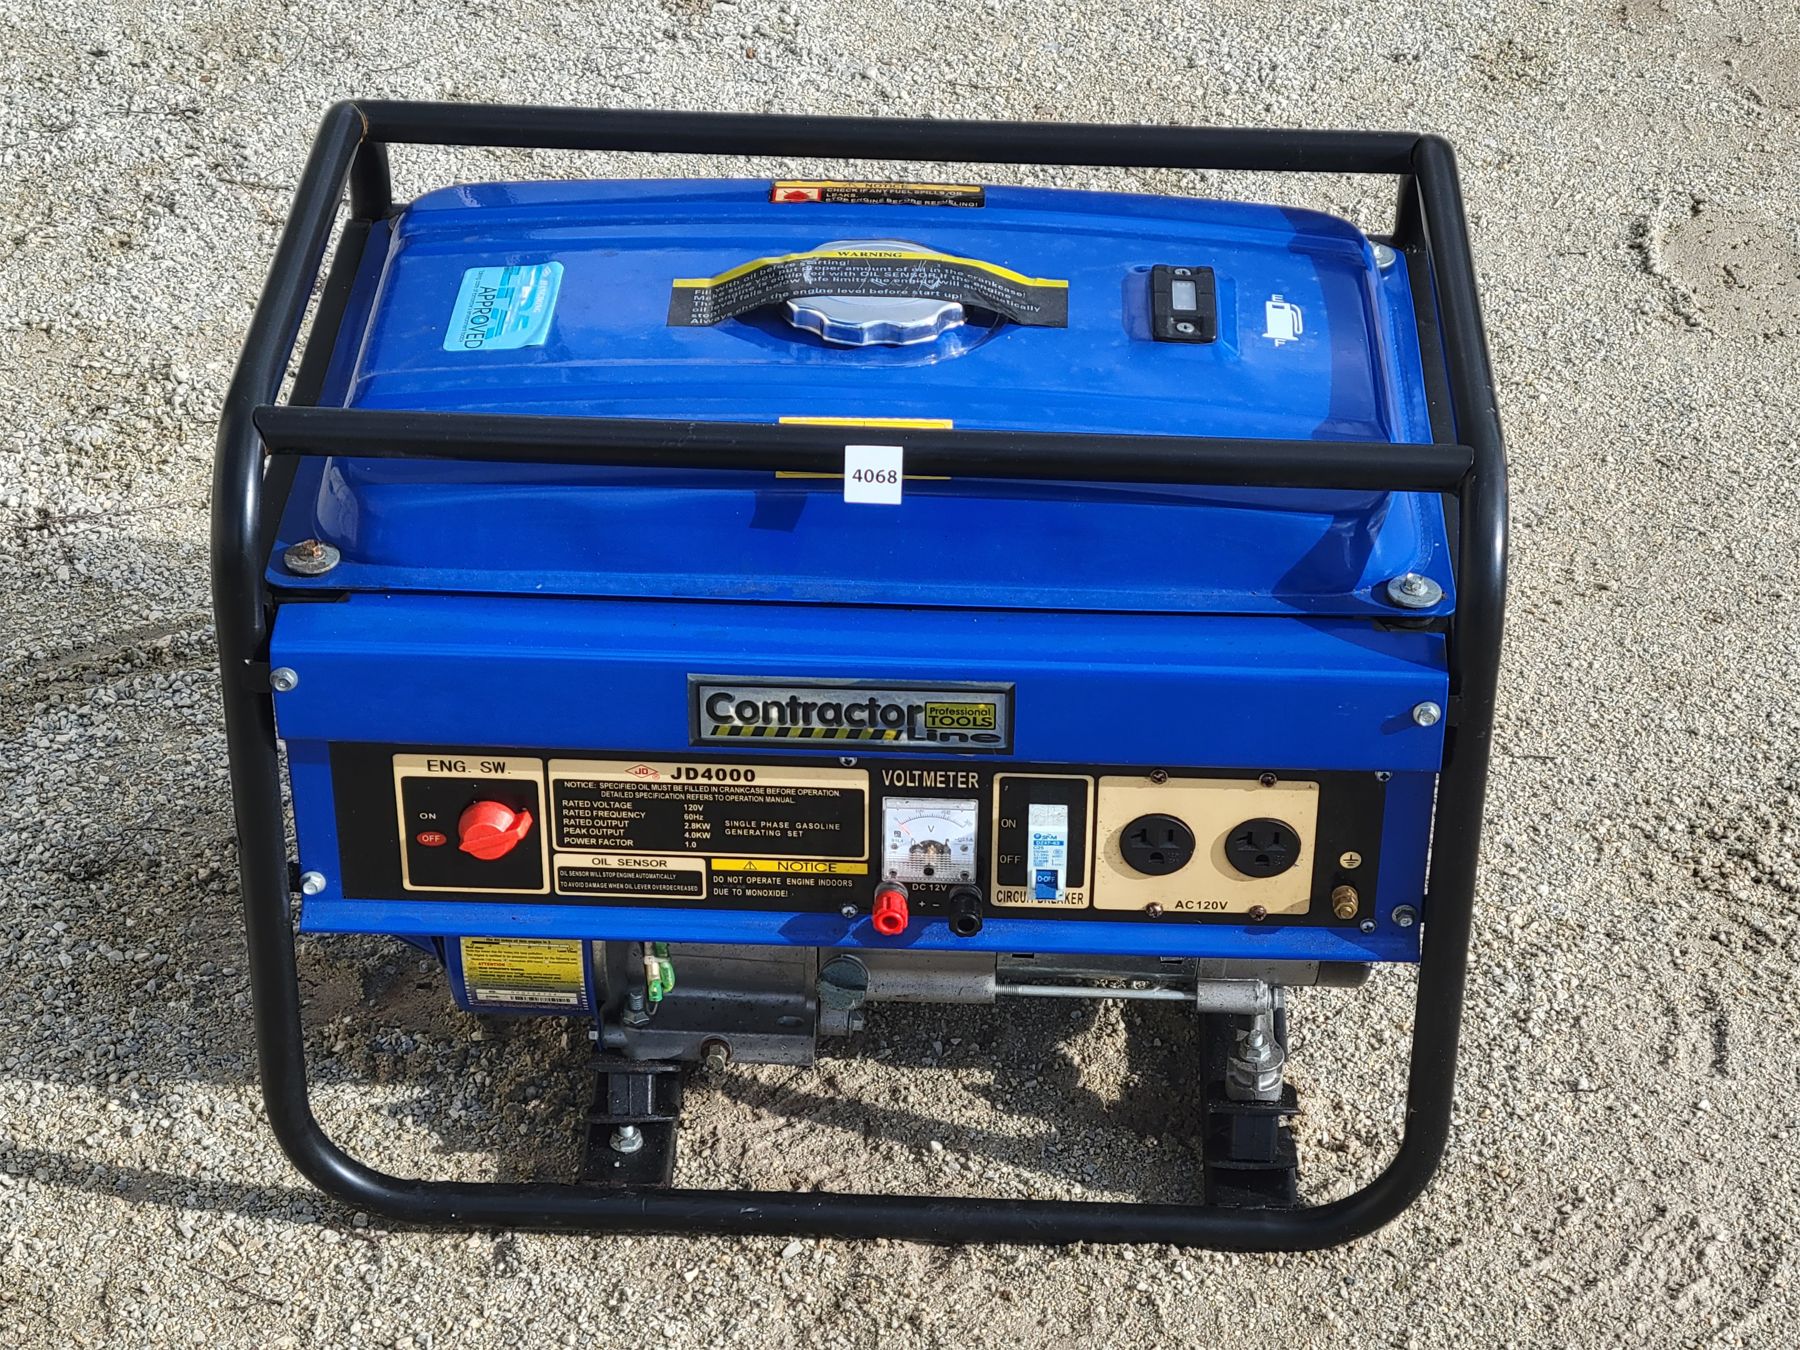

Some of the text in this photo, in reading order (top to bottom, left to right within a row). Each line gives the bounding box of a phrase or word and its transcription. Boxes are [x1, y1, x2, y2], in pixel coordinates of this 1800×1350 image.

[715, 280, 740, 292] with
[744, 273, 757, 281] oil
[760, 262, 796, 275] before
[694, 291, 725, 301] Make
[728, 281, 754, 293] sure
[756, 273, 775, 284] you
[779, 267, 799, 275] put
[718, 286, 755, 303] engine
[770, 270, 825, 284] equiped
[711, 298, 737, 312] level
[740, 290, 762, 301] falls
[766, 278, 800, 292] below
[1272, 294, 1284, 302] E
[690, 312, 732, 325] Always
[793, 288, 834, 296] engine
[464, 286, 497, 349] APPROVED
[1275, 339, 1287, 347] F
[852, 469, 898, 485] 4068
[705, 692, 924, 728] Contractor
[930, 706, 992, 717] Professional
[928, 716, 994, 728] TOOLS
[907, 726, 1002, 744] Line
[427, 760, 512, 775] ENG. SW.
[671, 767, 756, 783] JD4000
[882, 770, 980, 789] VOLTMETER
[601, 791, 634, 799] DETAILED
[635, 792, 685, 800] SPECIFICATION
[687, 793, 714, 801] REFERS
[725, 795, 764, 803] OPERATION
[563, 800, 704, 812] RATED VOLTAGE 120V
[593, 811, 646, 819] FREQUENCY
[563, 819, 593, 827] RATED
[594, 820, 630, 828] OUTPUT
[725, 820, 841, 831] SINGLE PHASE GASOLINE
[928, 825, 935, 833] V
[1001, 819, 1017, 829] ON
[591, 829, 625, 837] OUTPUT
[725, 829, 782, 837] GENERATING
[564, 838, 599, 846] POWER
[599, 839, 634, 847] FACTOR
[592, 858, 668, 868] OIL SENSOR
[1000, 855, 1022, 864] OFF
[778, 862, 838, 873] NOTICE
[713, 876, 853, 887] DO NOT OPERATE ENGINE INDOORS
[652, 884, 699, 892] OVERDECREASED
[714, 888, 729, 896] DUE
[746, 889, 788, 898] MONOXIDE!
[912, 883, 948, 892] DC 12V
[997, 890, 1034, 903] CIRCU
[1175, 900, 1229, 911] AC 120V
